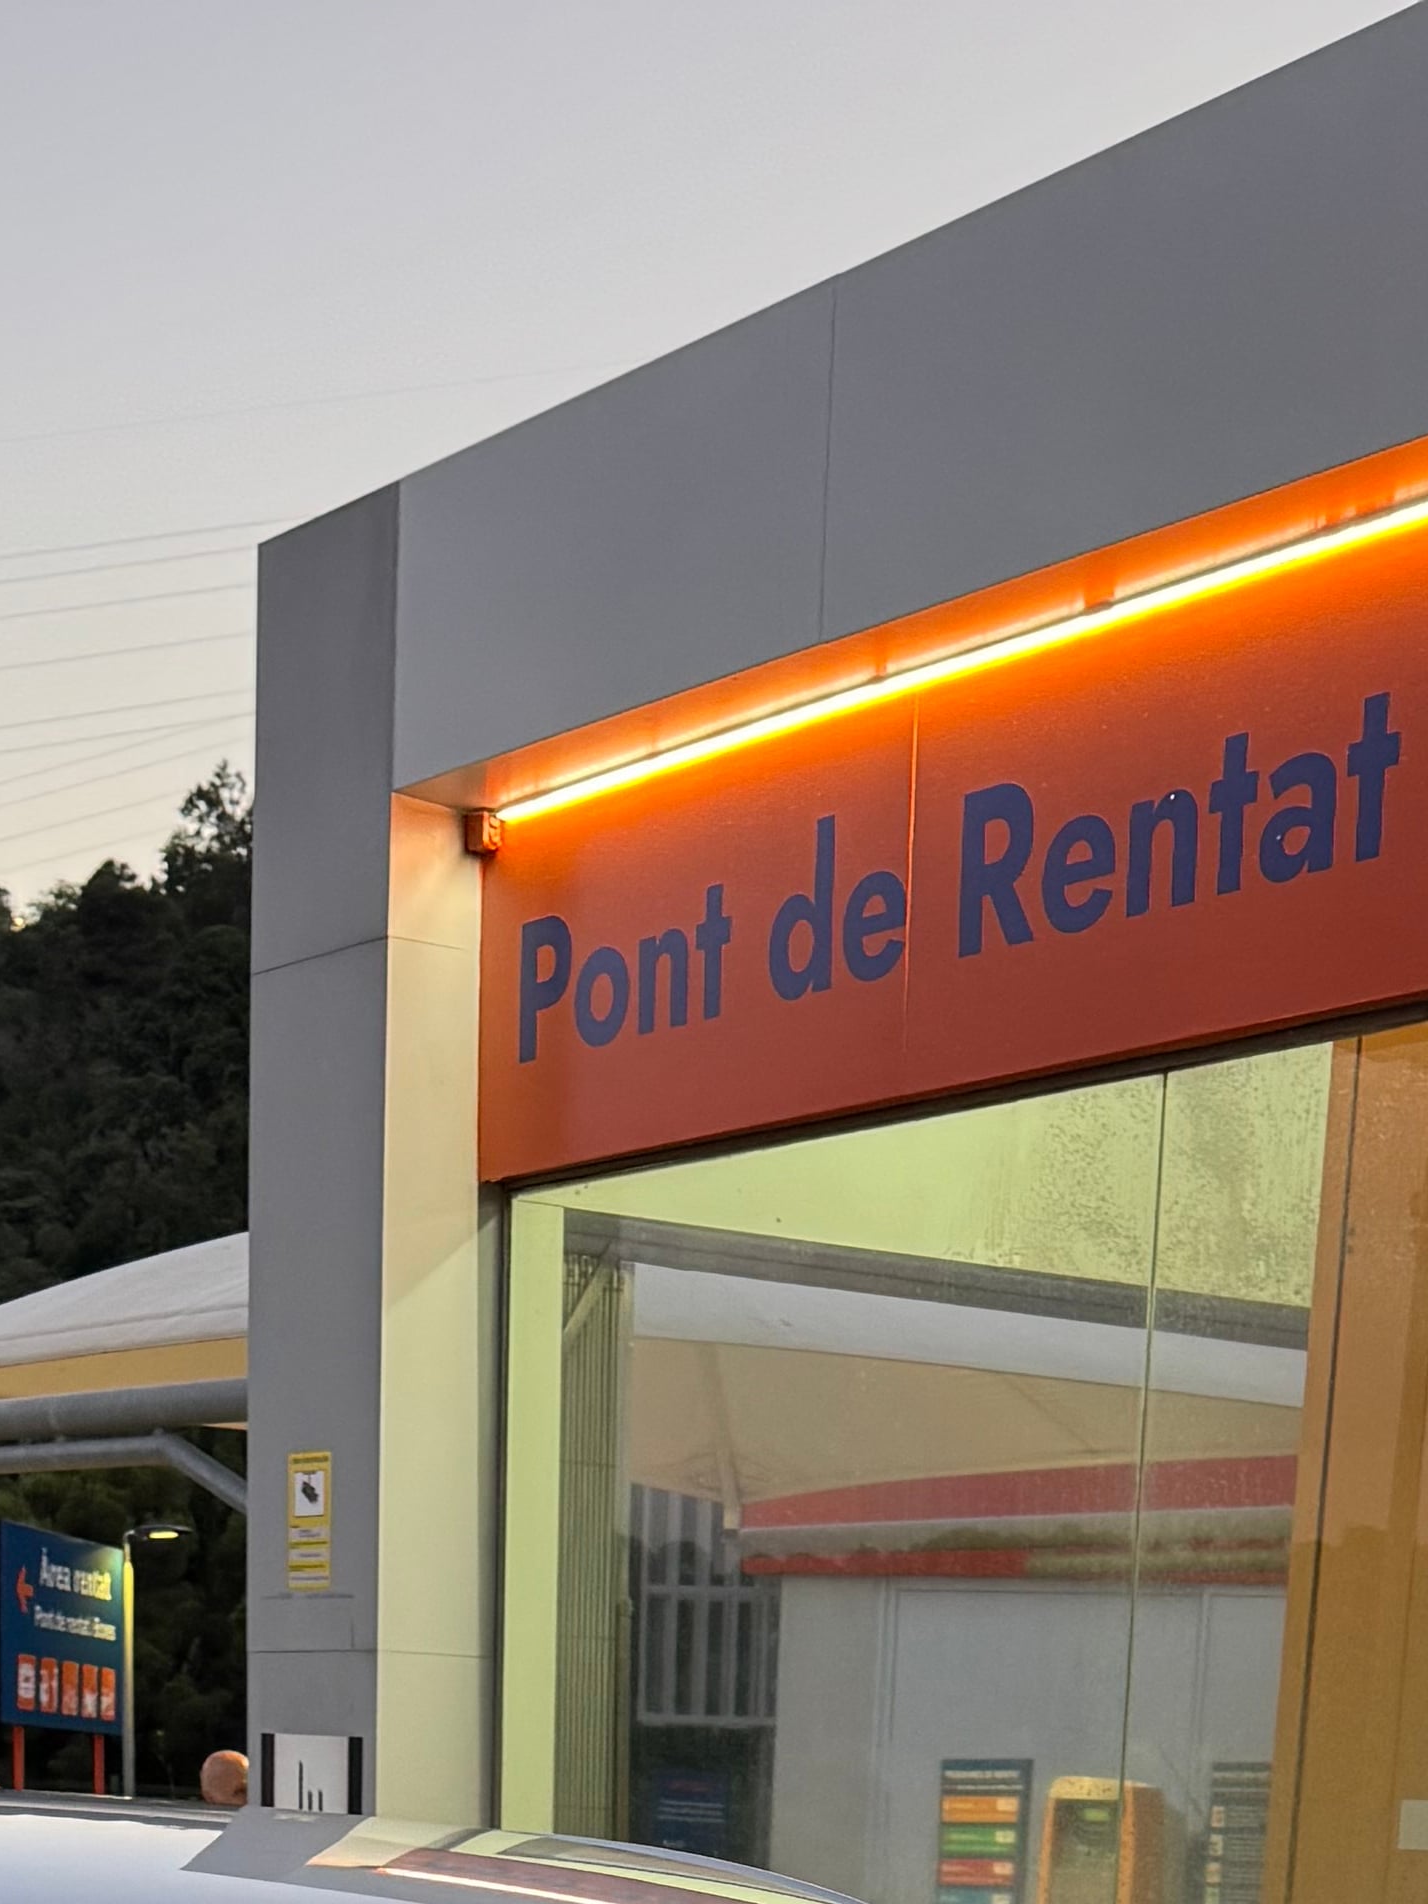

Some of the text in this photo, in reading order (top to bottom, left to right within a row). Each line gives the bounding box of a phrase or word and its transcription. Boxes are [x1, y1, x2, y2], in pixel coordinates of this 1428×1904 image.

[518, 691, 1402, 1063] Pont de Rentat
